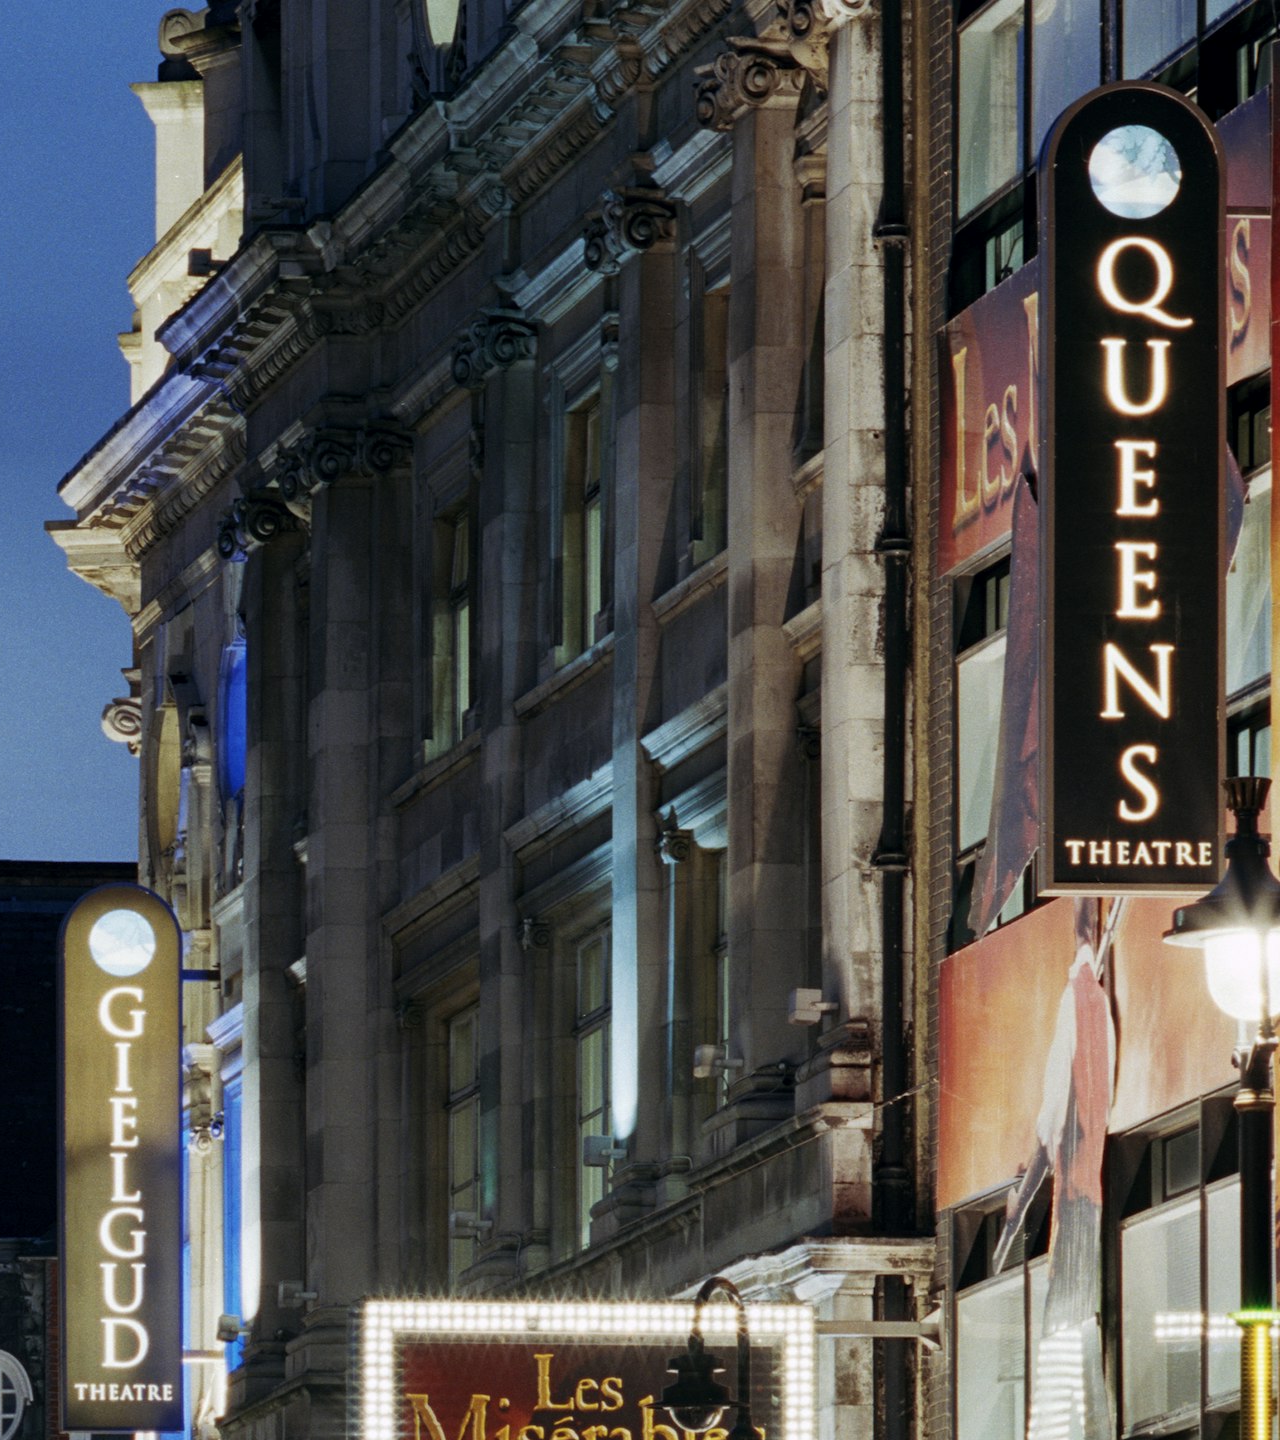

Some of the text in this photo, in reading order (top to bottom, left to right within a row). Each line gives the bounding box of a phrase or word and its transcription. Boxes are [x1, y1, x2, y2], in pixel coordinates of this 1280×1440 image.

[952, 345, 1018, 533] Les
[1096, 236, 1193, 822] QUEENS
[1064, 839, 1212, 866] THEATRE
[97, 986, 149, 1368] GIELGUD
[74, 1383, 173, 1402] THEATRE
[533, 1353, 624, 1412] Les
